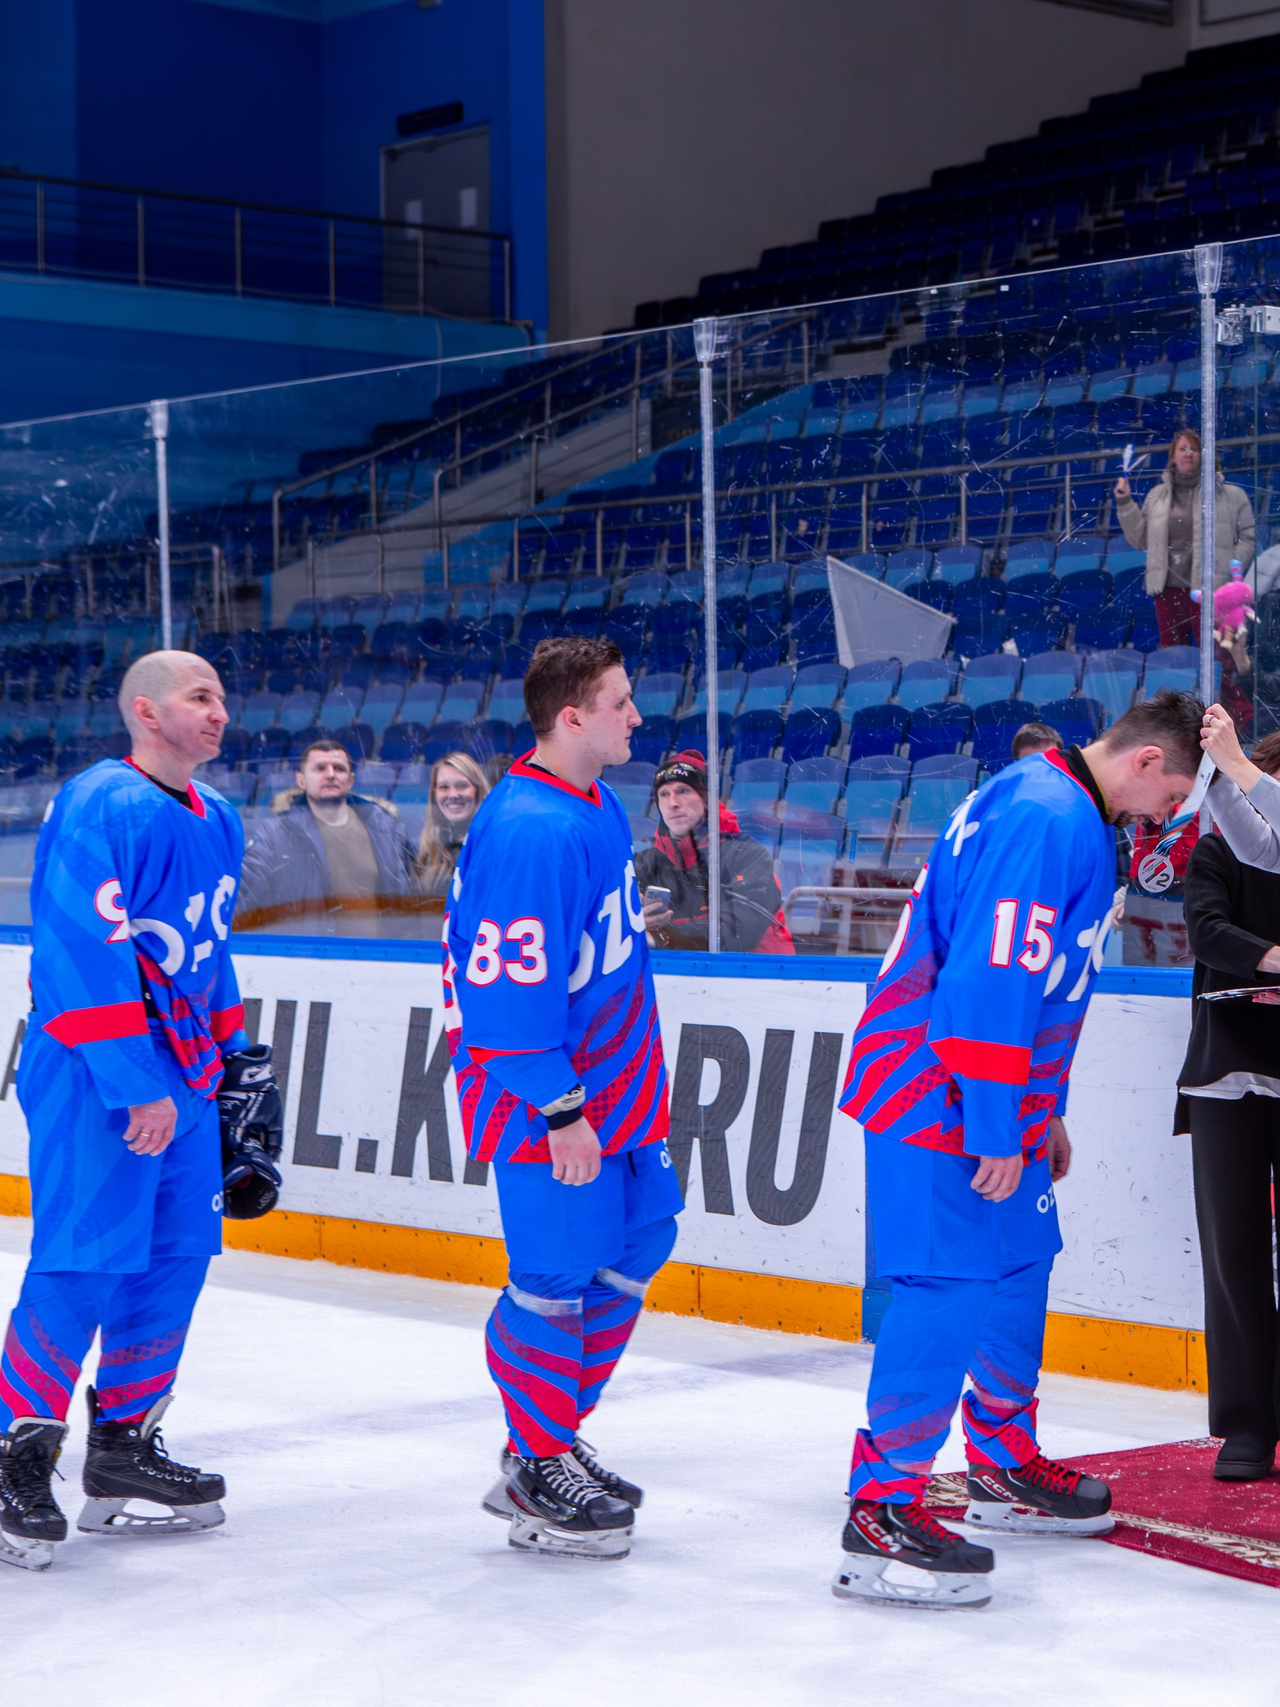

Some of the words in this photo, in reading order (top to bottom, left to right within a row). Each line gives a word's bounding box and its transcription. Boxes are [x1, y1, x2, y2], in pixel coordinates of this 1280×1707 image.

[465, 916, 548, 987] 83
[989, 898, 1059, 974] 15
[982, 1474, 1019, 1502] CCM
[855, 1509, 901, 1554] CCM
